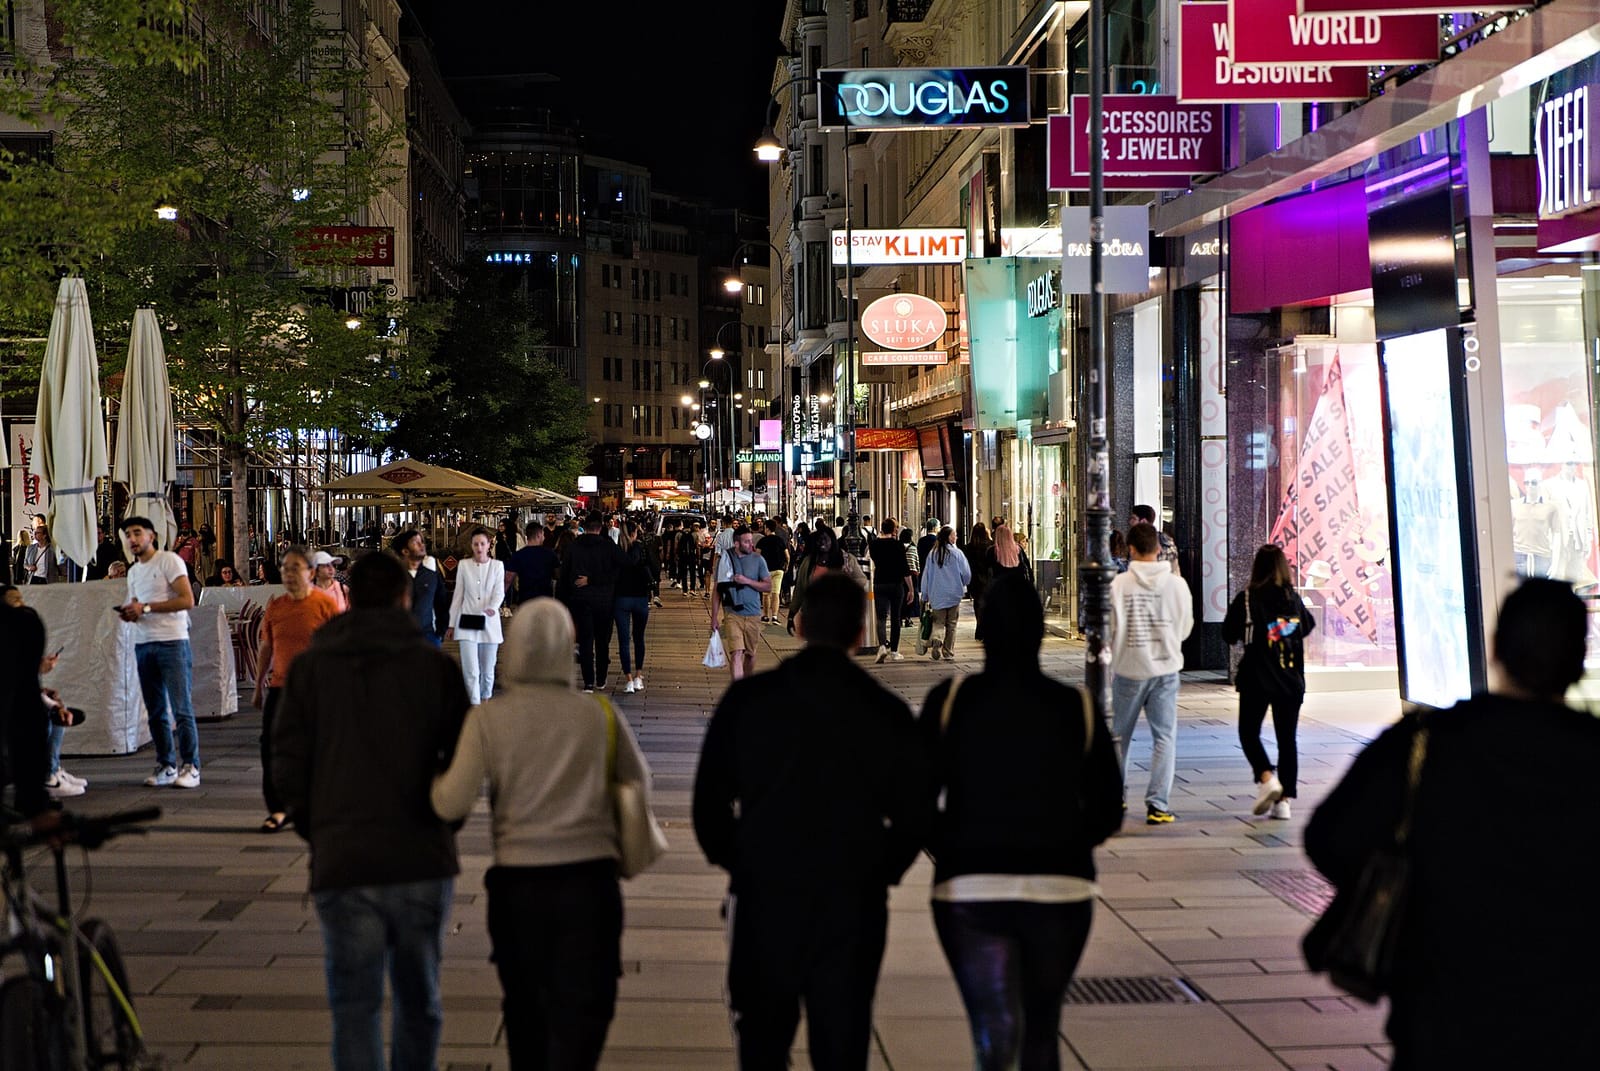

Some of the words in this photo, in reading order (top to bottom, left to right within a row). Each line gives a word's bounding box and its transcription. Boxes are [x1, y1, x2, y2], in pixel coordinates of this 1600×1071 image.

[1289, 15, 1382, 45] WORLD
[1215, 56, 1333, 84] DESIGNER
[837, 80, 1009, 116] DOUGLAS
[1085, 111, 1212, 134] CCESSOIRES
[1117, 137, 1203, 160] JEWELRY
[1535, 85, 1591, 217] STEFFL
[885, 235, 965, 256] KLIMT
[871, 319, 938, 335] SLUKA
[736, 453, 782, 462] SALMAND
[1302, 440, 1342, 488] SALE
[1314, 463, 1355, 512] SALE
[1272, 507, 1313, 550] SALE
